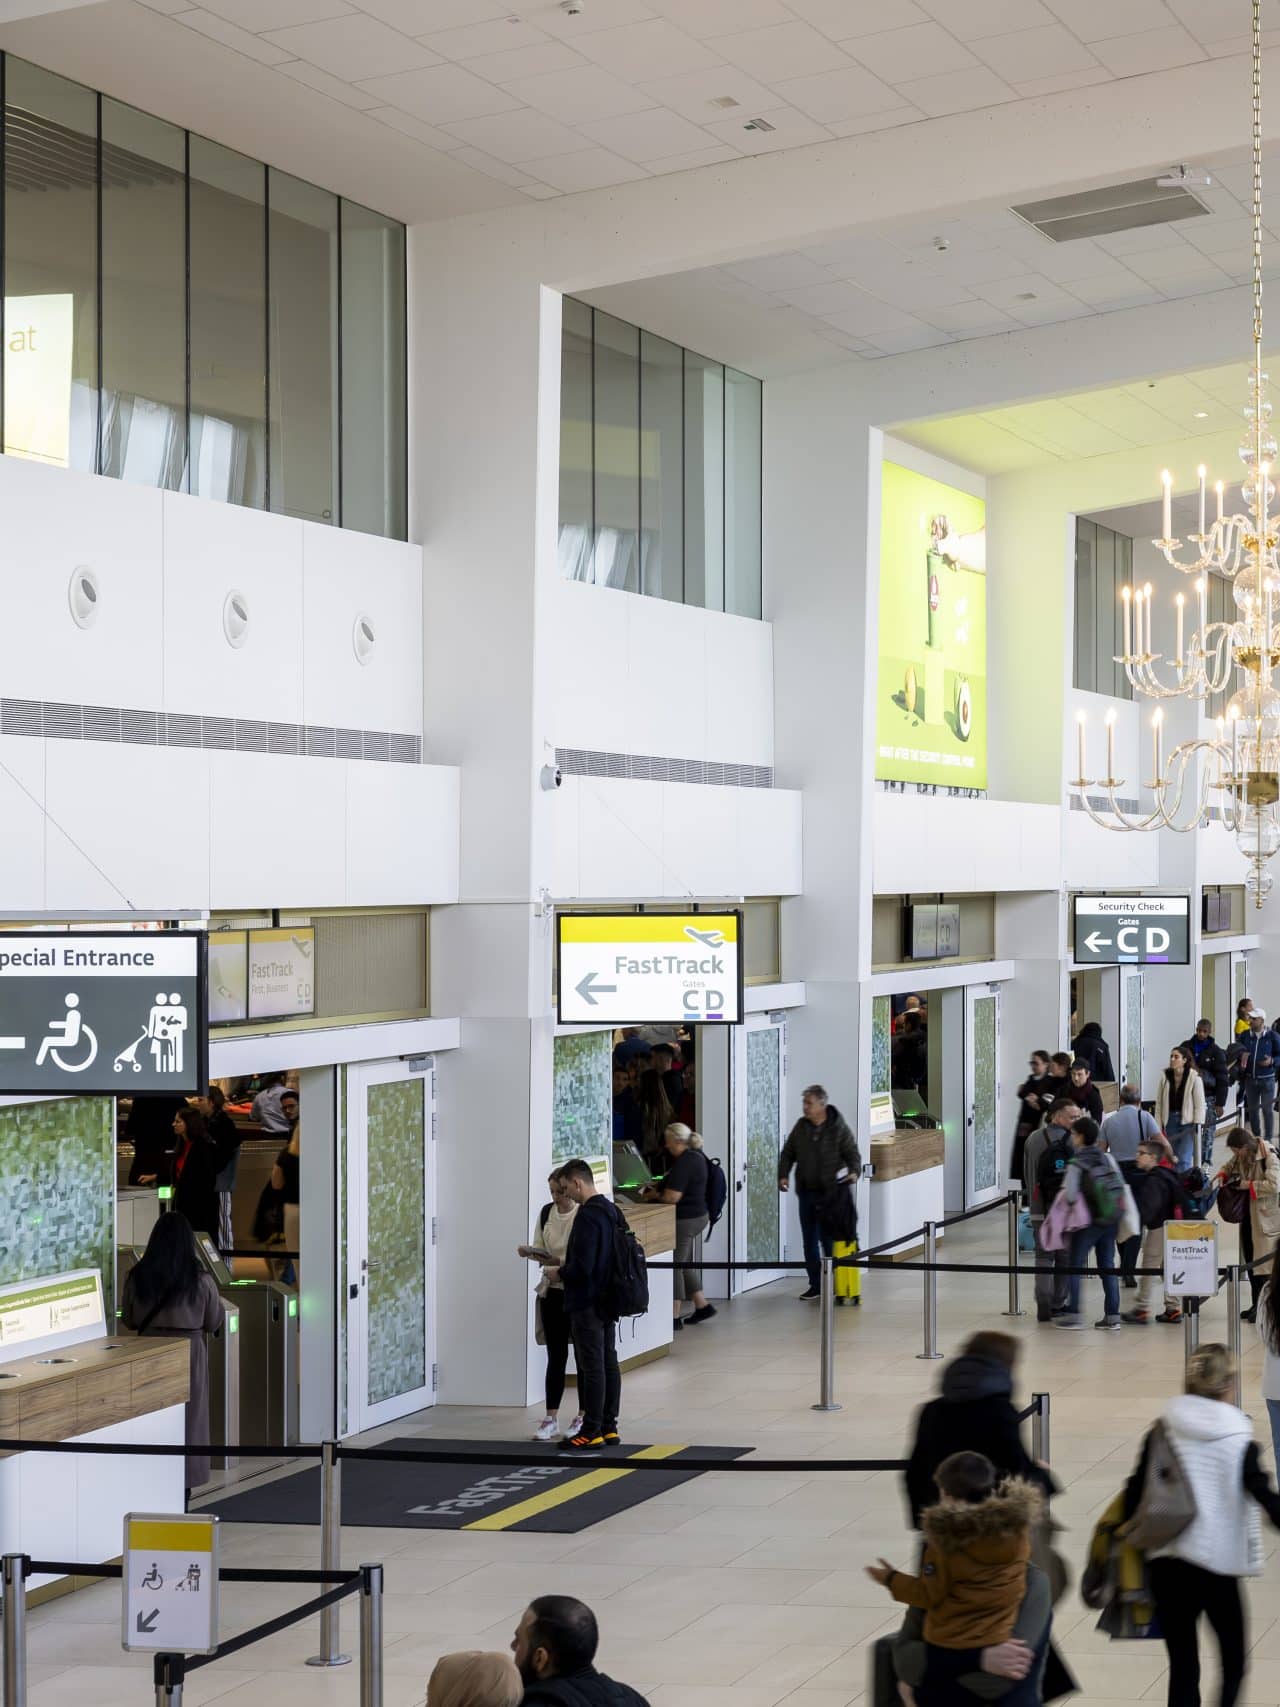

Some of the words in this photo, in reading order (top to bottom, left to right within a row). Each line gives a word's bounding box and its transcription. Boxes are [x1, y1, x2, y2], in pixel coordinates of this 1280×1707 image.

[1098, 902, 1136, 912] Security
[1137, 902, 1165, 911] Check
[1118, 918, 1140, 926] Gates
[1117, 927, 1139, 954] C
[1146, 927, 1170, 953] D
[0, 947, 56, 970] pecial
[63, 948, 155, 967] Entrance
[682, 989, 699, 1011] C
[705, 989, 724, 1011] D
[1172, 1246, 1209, 1254] FastTrack
[404, 1453, 602, 1515] FastTra
